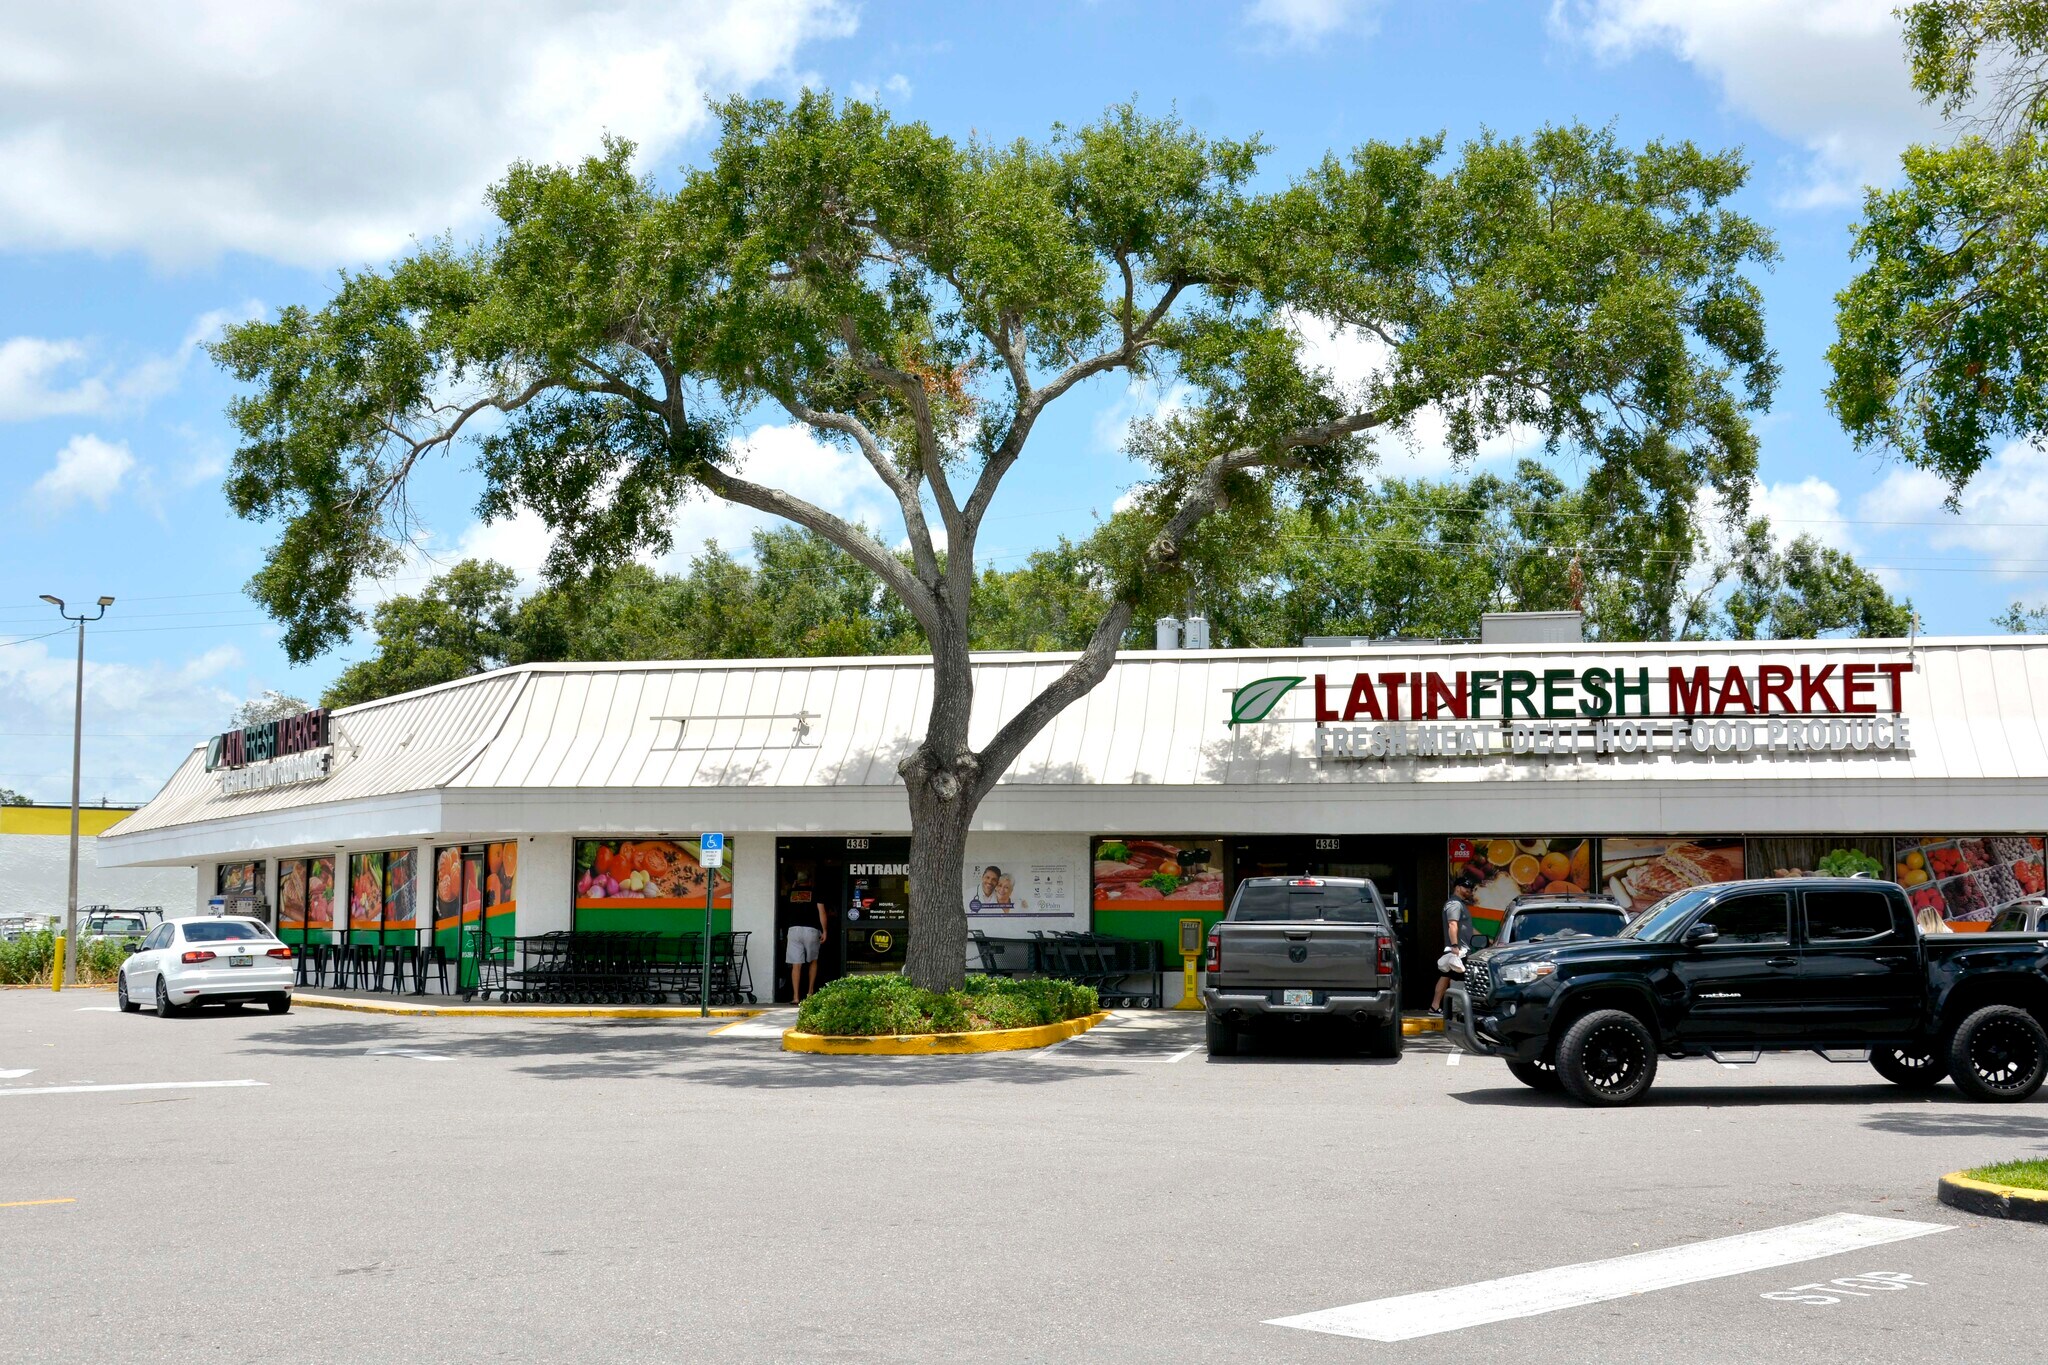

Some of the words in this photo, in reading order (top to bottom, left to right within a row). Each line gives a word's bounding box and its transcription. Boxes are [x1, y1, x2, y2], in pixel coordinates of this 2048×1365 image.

[1668, 663, 1913, 715] MARKET
[277, 709, 328, 755] MARKET
[1315, 726, 1407, 757] FRESH
[1418, 724, 1494, 756] MEAT
[1512, 722, 1579, 754] DELI
[1596, 720, 1658, 753] HOT
[1672, 719, 1754, 752] FOOD
[1767, 716, 1911, 751] PRODUCE
[847, 839, 868, 849] 4349
[1316, 839, 1339, 849] 4349
[850, 864, 910, 875] ENTRANC
[1760, 1271, 1928, 1304] STOP
